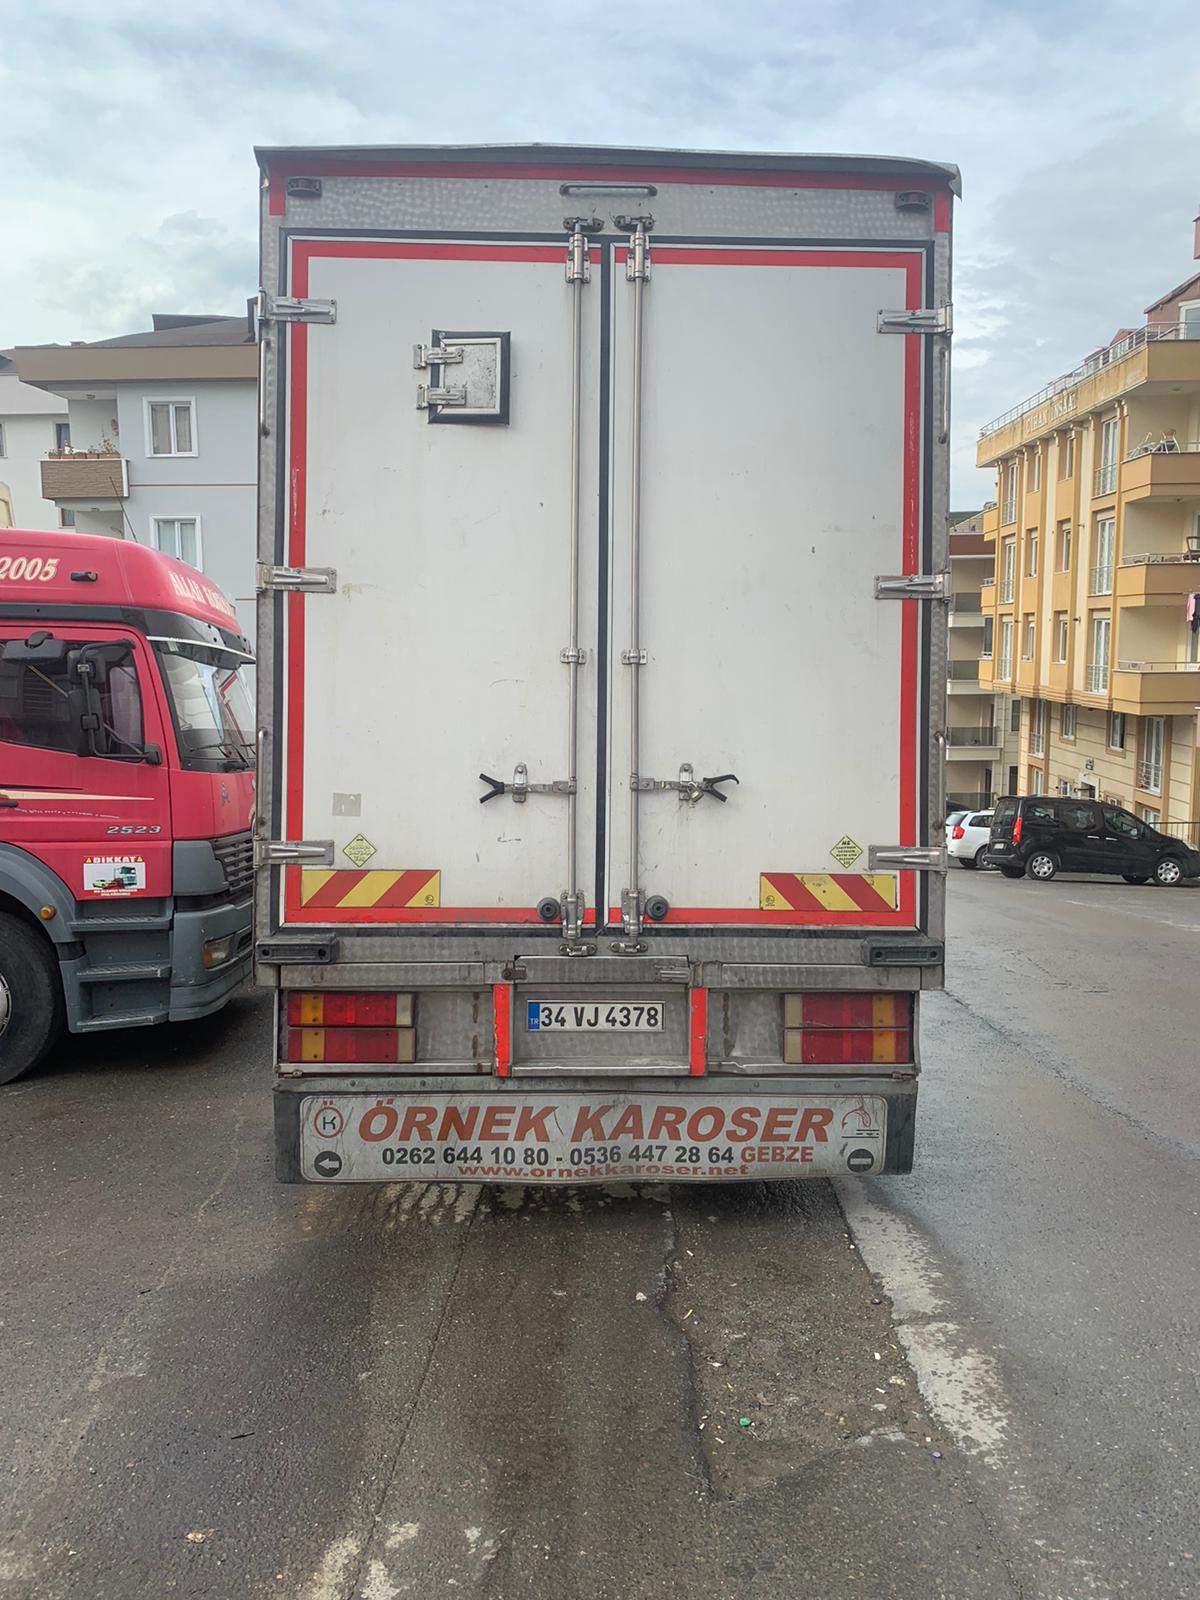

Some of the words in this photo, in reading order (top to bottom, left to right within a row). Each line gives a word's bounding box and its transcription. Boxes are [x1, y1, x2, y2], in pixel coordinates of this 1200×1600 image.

[0, 556, 59, 581] 2005
[106, 825, 161, 835] 2523
[530, 1017, 539, 1025] TR
[541, 1006, 567, 1028] 34
[573, 1006, 599, 1028] VJ
[605, 1006, 659, 1028] 4378
[358, 1098, 559, 1143] ÖRNEK
[570, 1103, 834, 1143] KAROSER
[382, 1147, 436, 1165] 0262
[443, 1147, 483, 1165] 644
[490, 1146, 516, 1165] 10
[523, 1148, 549, 1166] 80
[570, 1145, 622, 1166] 0536
[628, 1145, 668, 1163] 447
[674, 1146, 700, 1164] 28
[708, 1146, 735, 1164] 64
[740, 1145, 814, 1163] GEBZE
[457, 1163, 750, 1178] www.ornekkaroser.net
